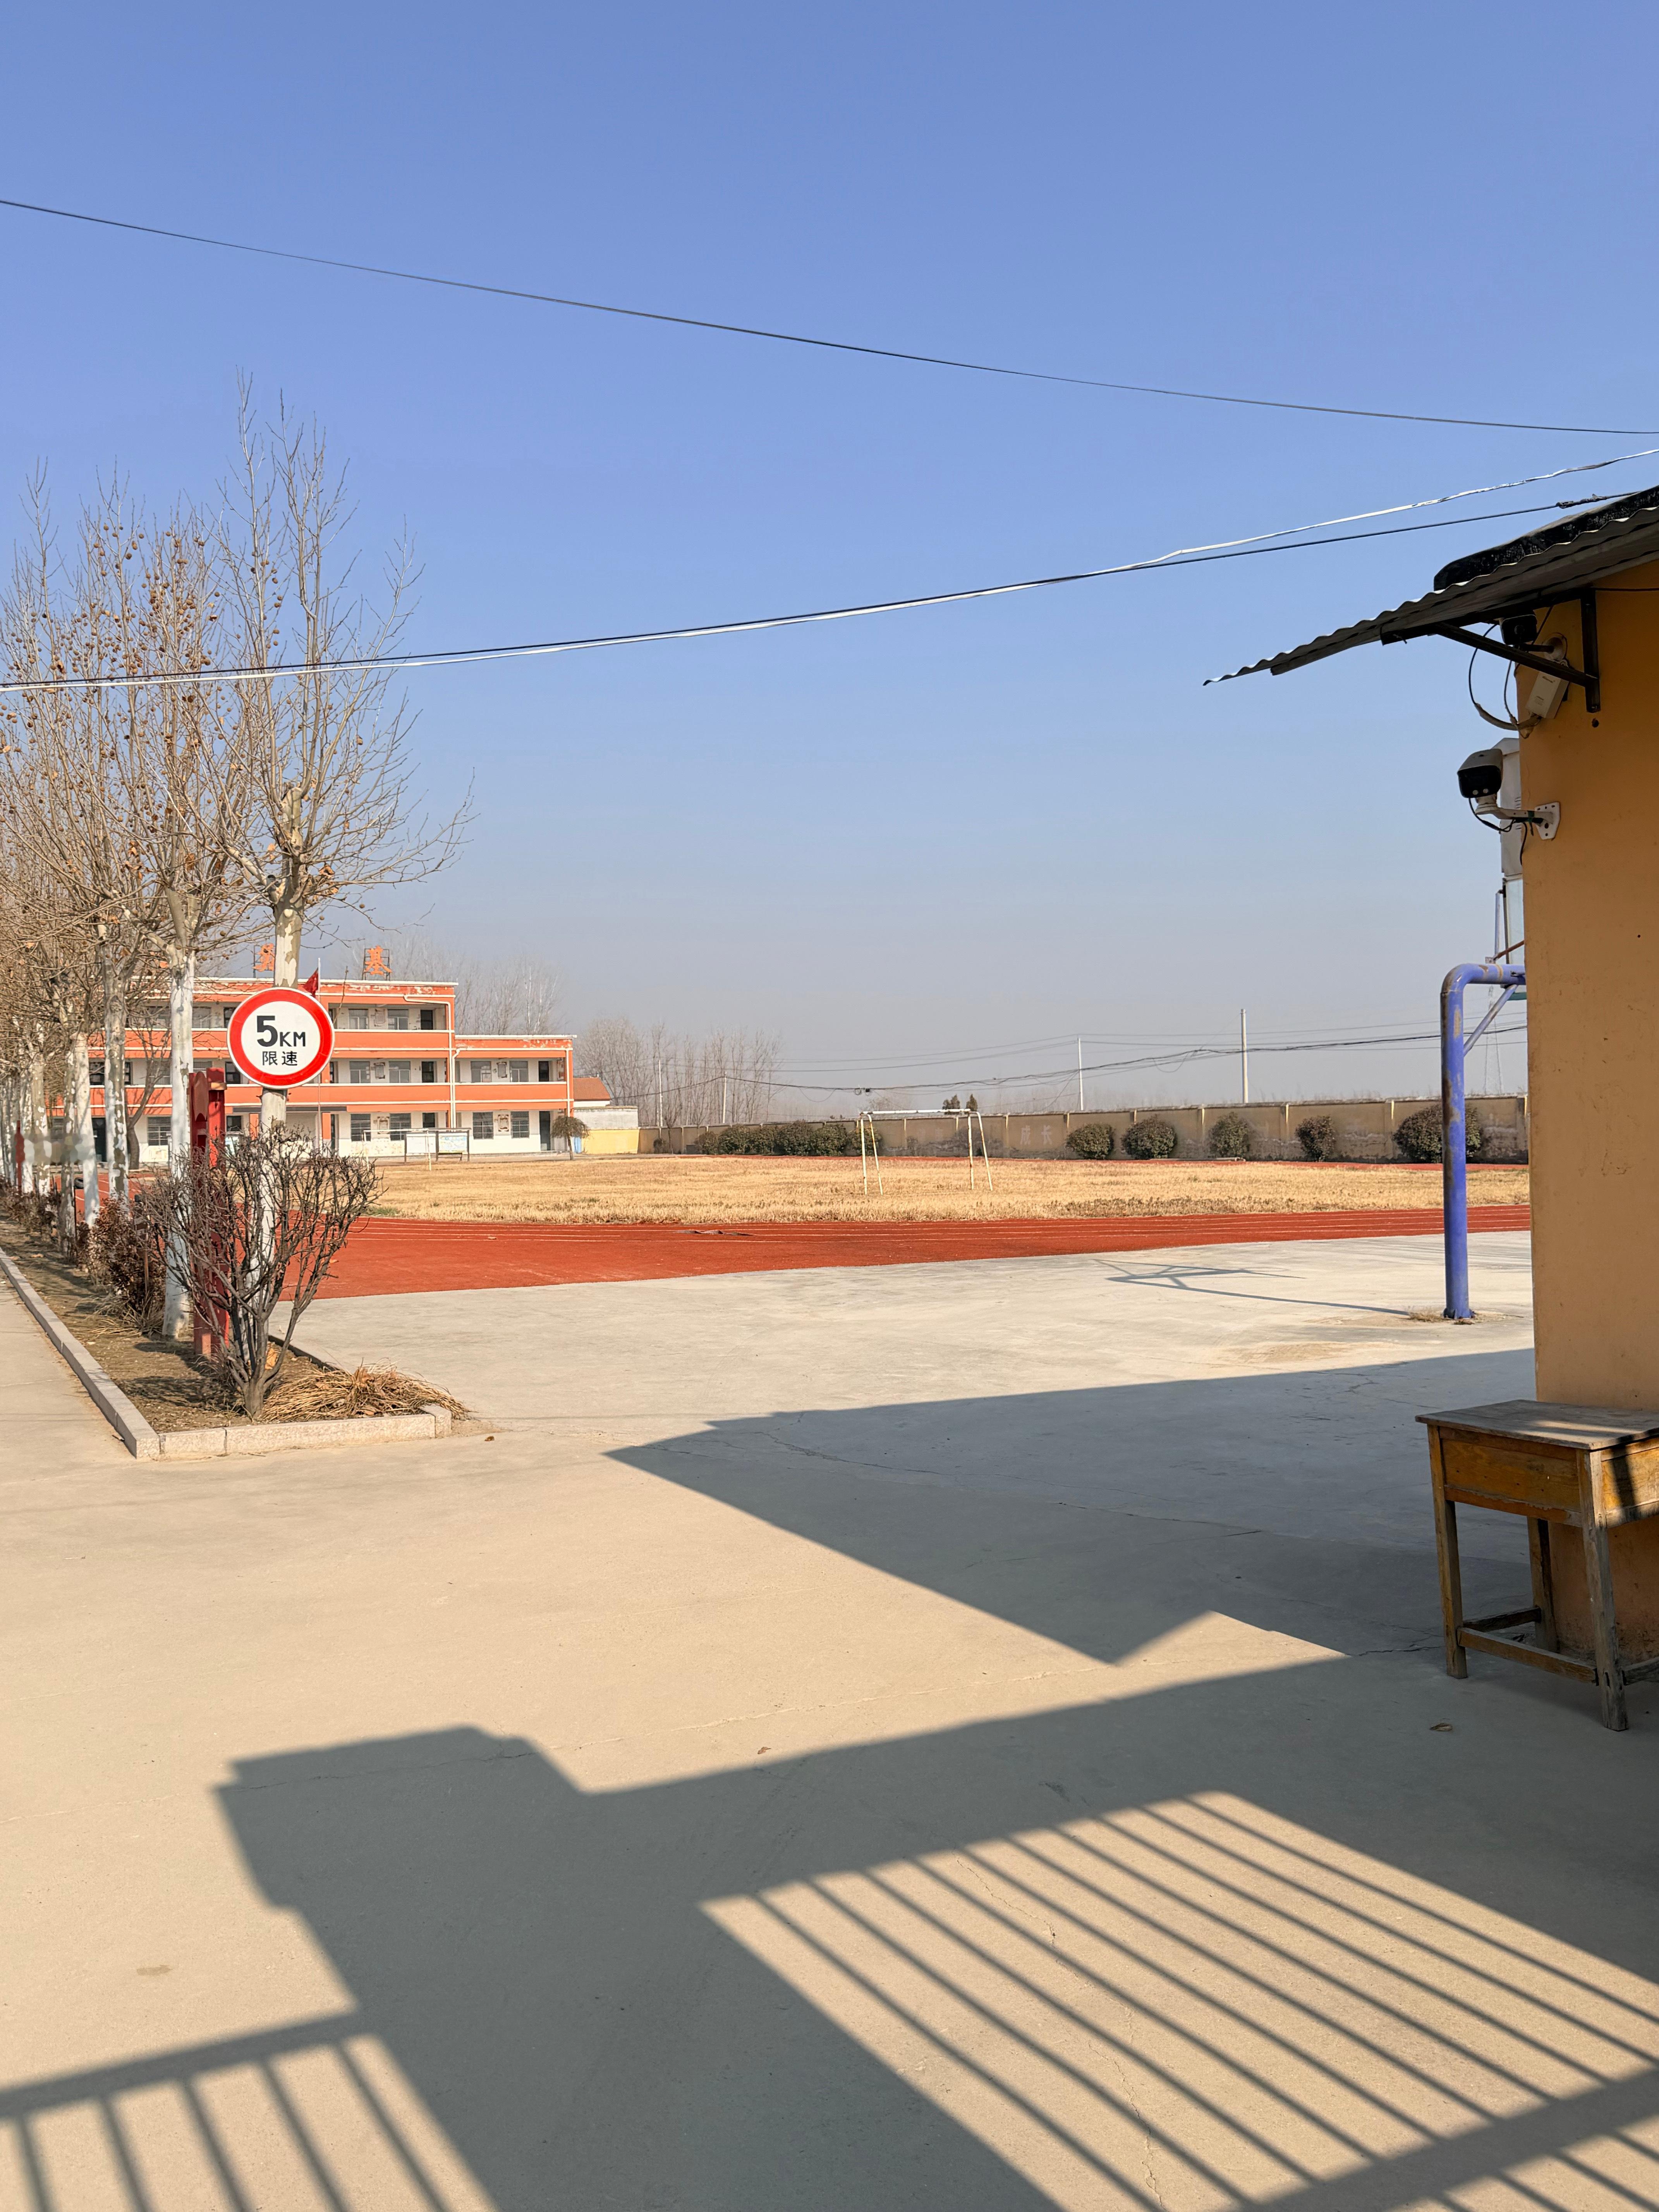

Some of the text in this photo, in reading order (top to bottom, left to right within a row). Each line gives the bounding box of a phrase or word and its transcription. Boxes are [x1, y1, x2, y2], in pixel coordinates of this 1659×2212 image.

[364, 945, 392, 975] 基
[257, 1016, 306, 1047] 5KM
[262, 1051, 297, 1065] 限速
[1020, 1125, 1053, 1145] 成长
